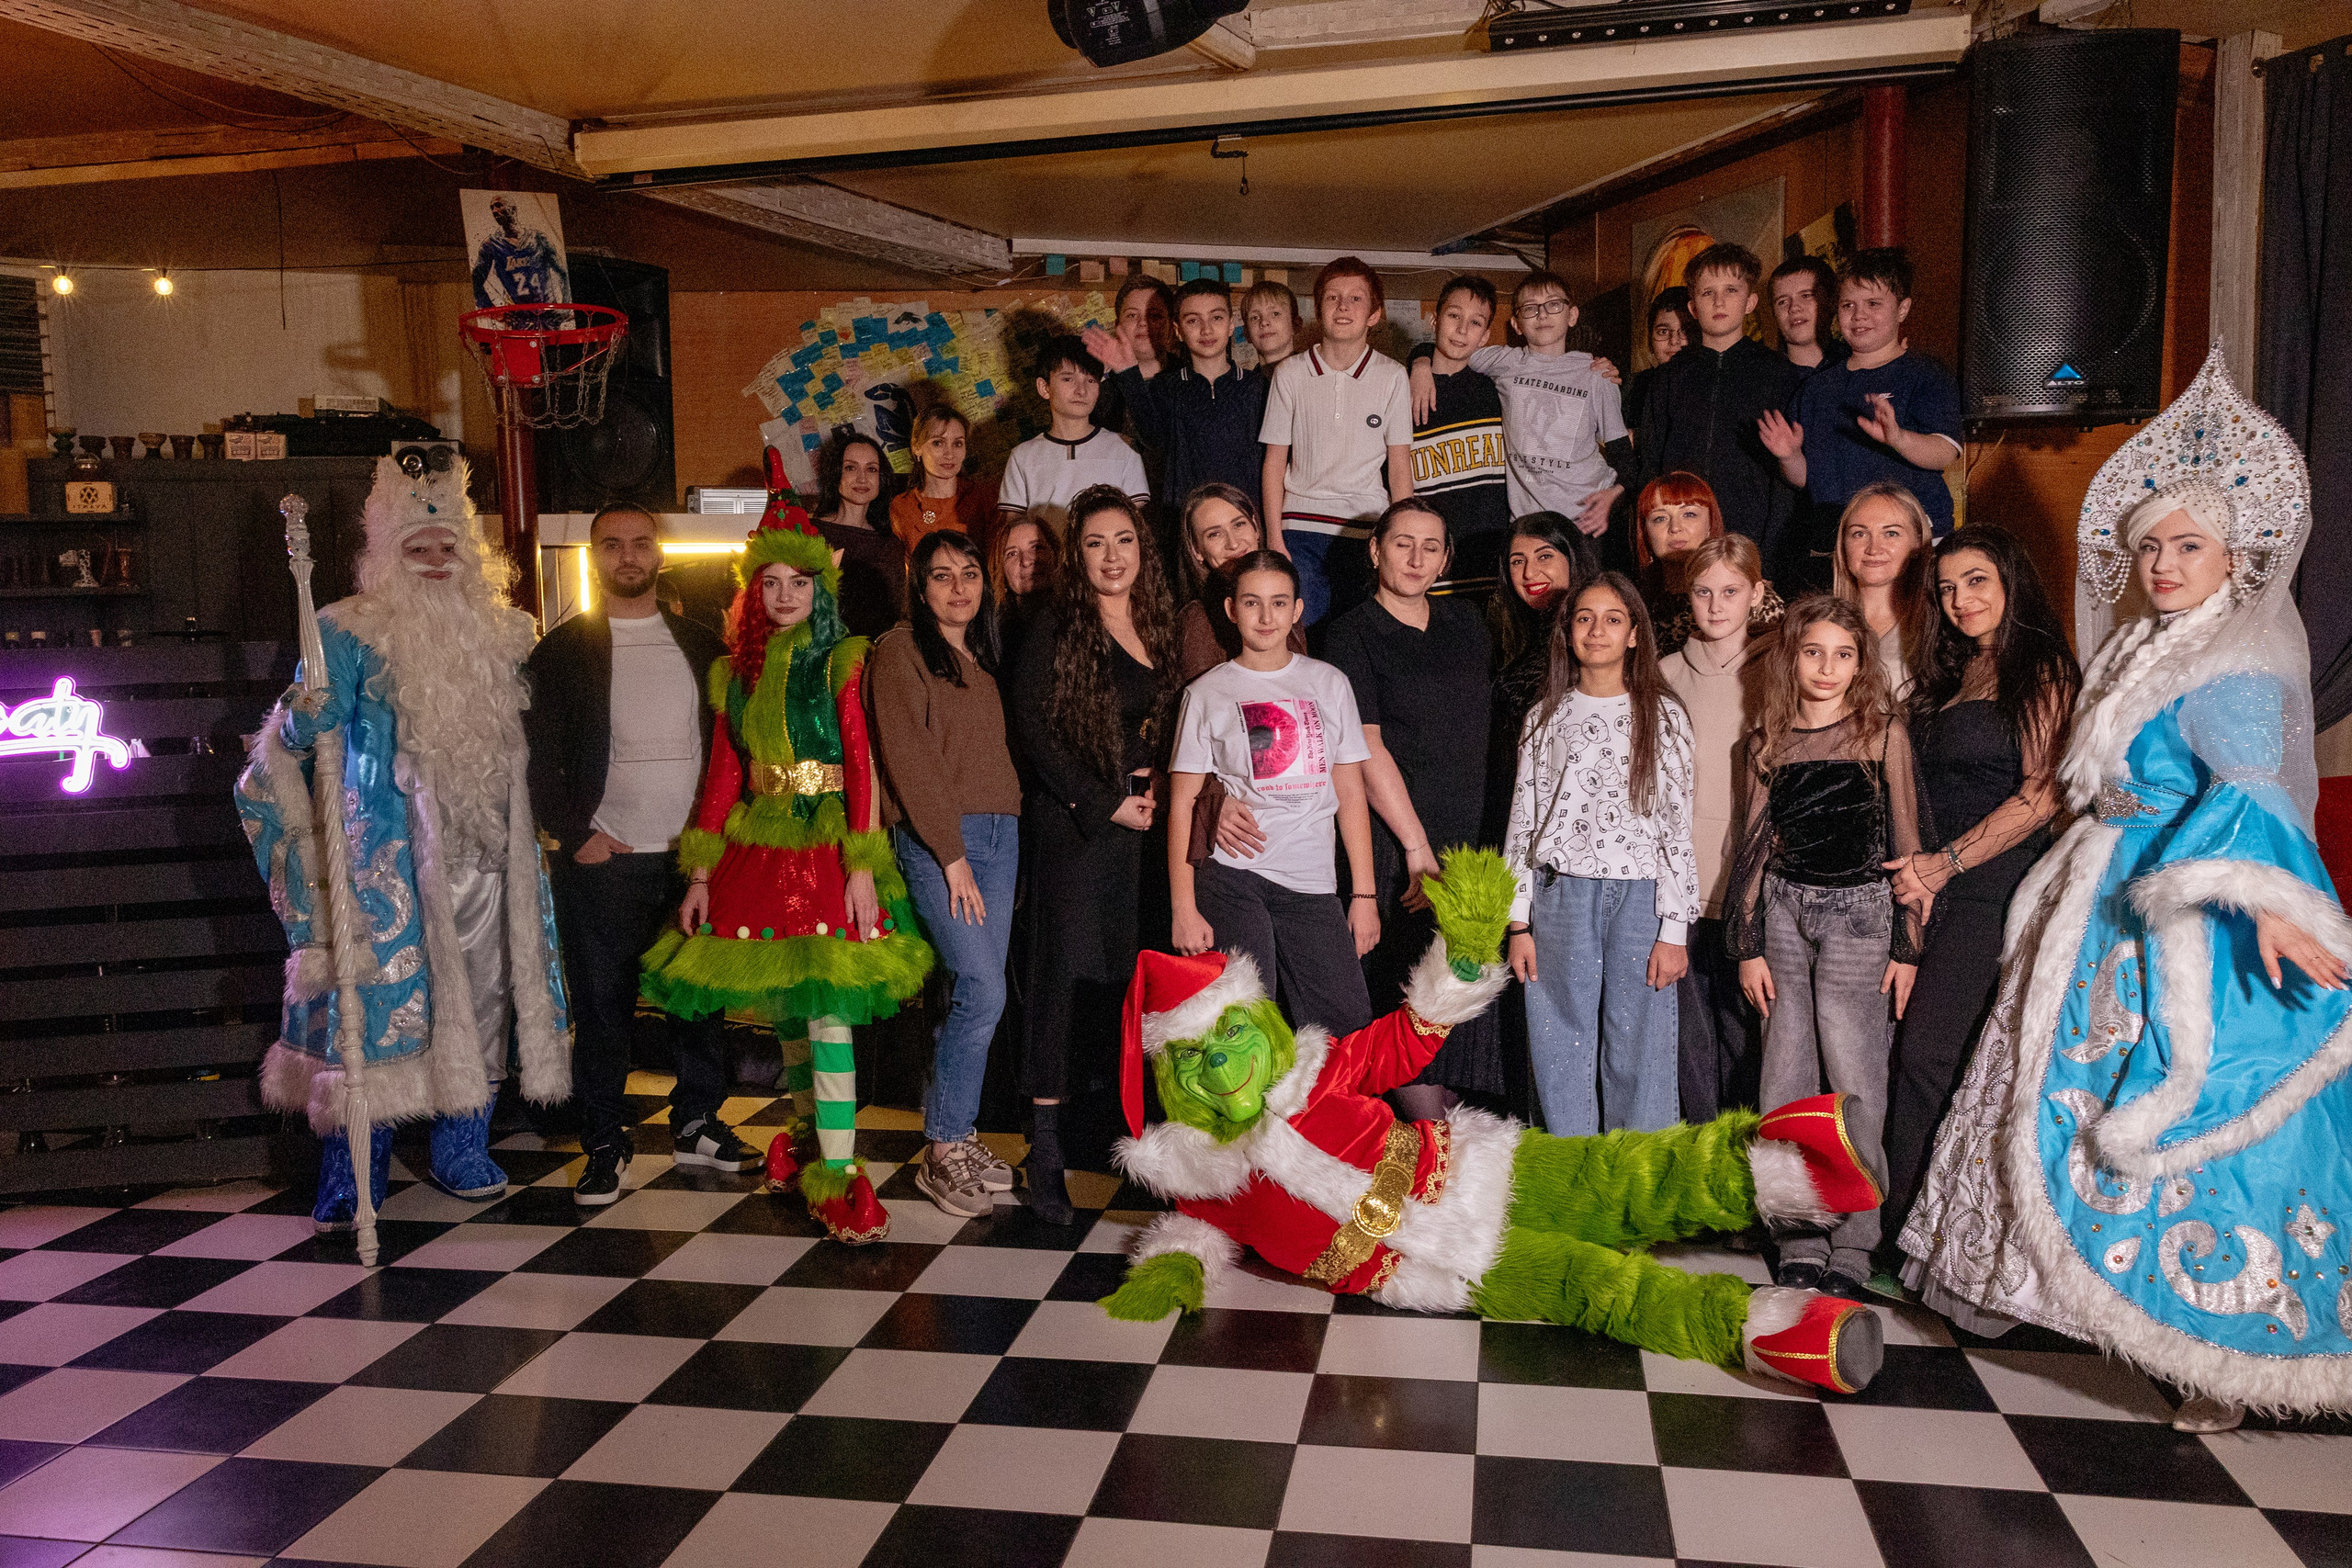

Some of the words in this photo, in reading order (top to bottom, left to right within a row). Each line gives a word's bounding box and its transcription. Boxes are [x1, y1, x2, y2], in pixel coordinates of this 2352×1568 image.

[512, 273, 542, 296] 24
[1513, 377, 1589, 398] SKATEBOARDING
[1410, 434, 1506, 481] UNREAL
[1307, 701, 1318, 718] MOON
[1314, 720, 1321, 730] ON
[1316, 733, 1324, 754] WALK
[1318, 757, 1327, 773] MEN
